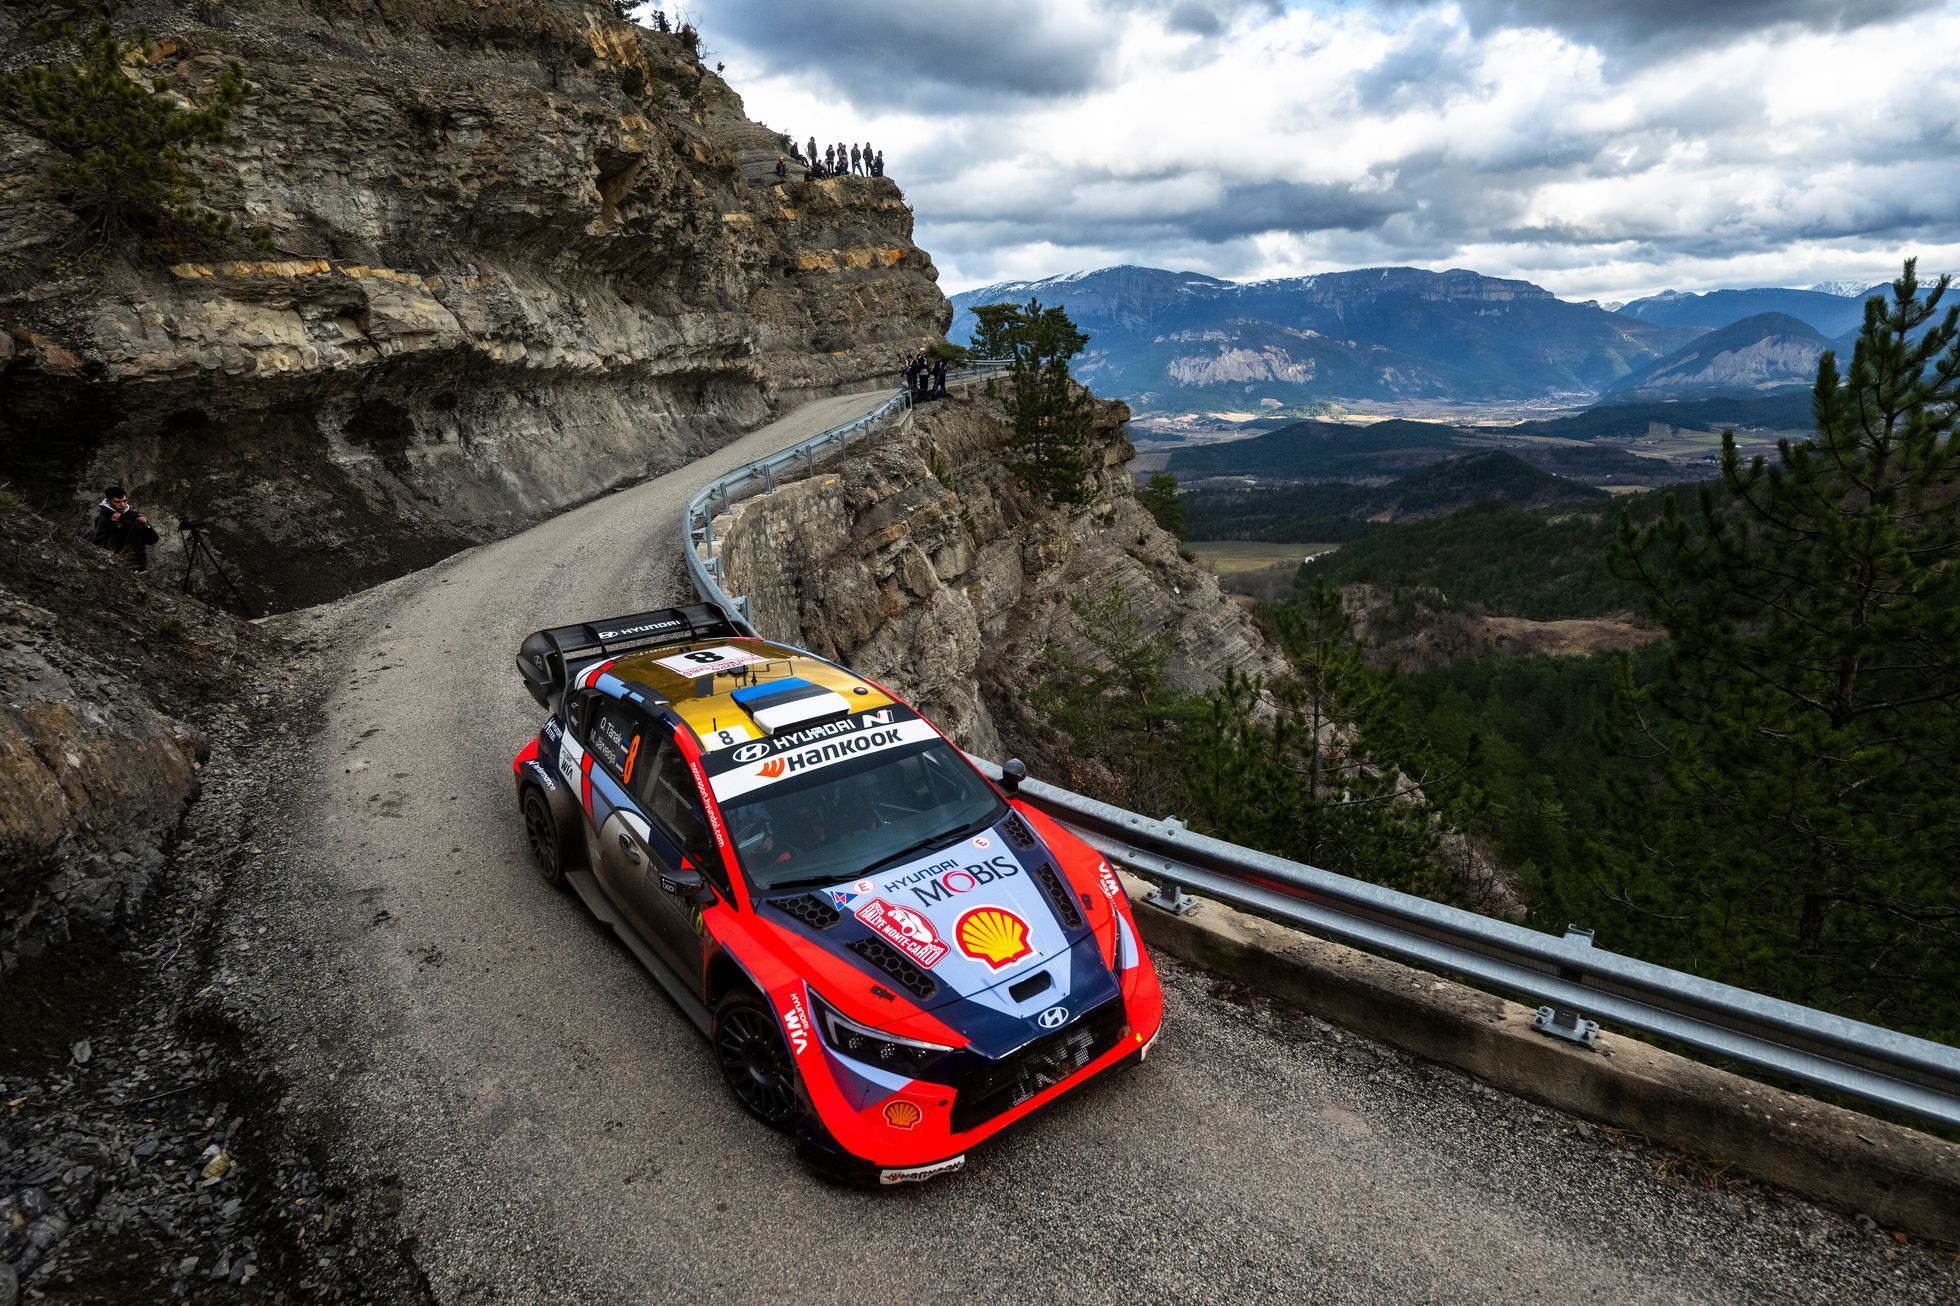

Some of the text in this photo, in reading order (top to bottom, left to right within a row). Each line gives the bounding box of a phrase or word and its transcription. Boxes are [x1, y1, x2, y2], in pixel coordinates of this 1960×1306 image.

[621, 620, 681, 635] HYUNDAI
[684, 651, 725, 664] 8
[718, 730, 735, 746] 8
[773, 719, 856, 750] HYUNDAI
[623, 734, 641, 785] 8
[690, 761, 725, 848] motorsport.hyundai.com
[884, 859, 959, 893] HYUNDAI
[910, 856, 1019, 908] MOBIS
[872, 900, 885, 915] 2025
[859, 905, 941, 965] RALLYE MONTE-CARLO
[791, 993, 810, 1029] HYUNDAI
[784, 1009, 808, 1055] WIA
